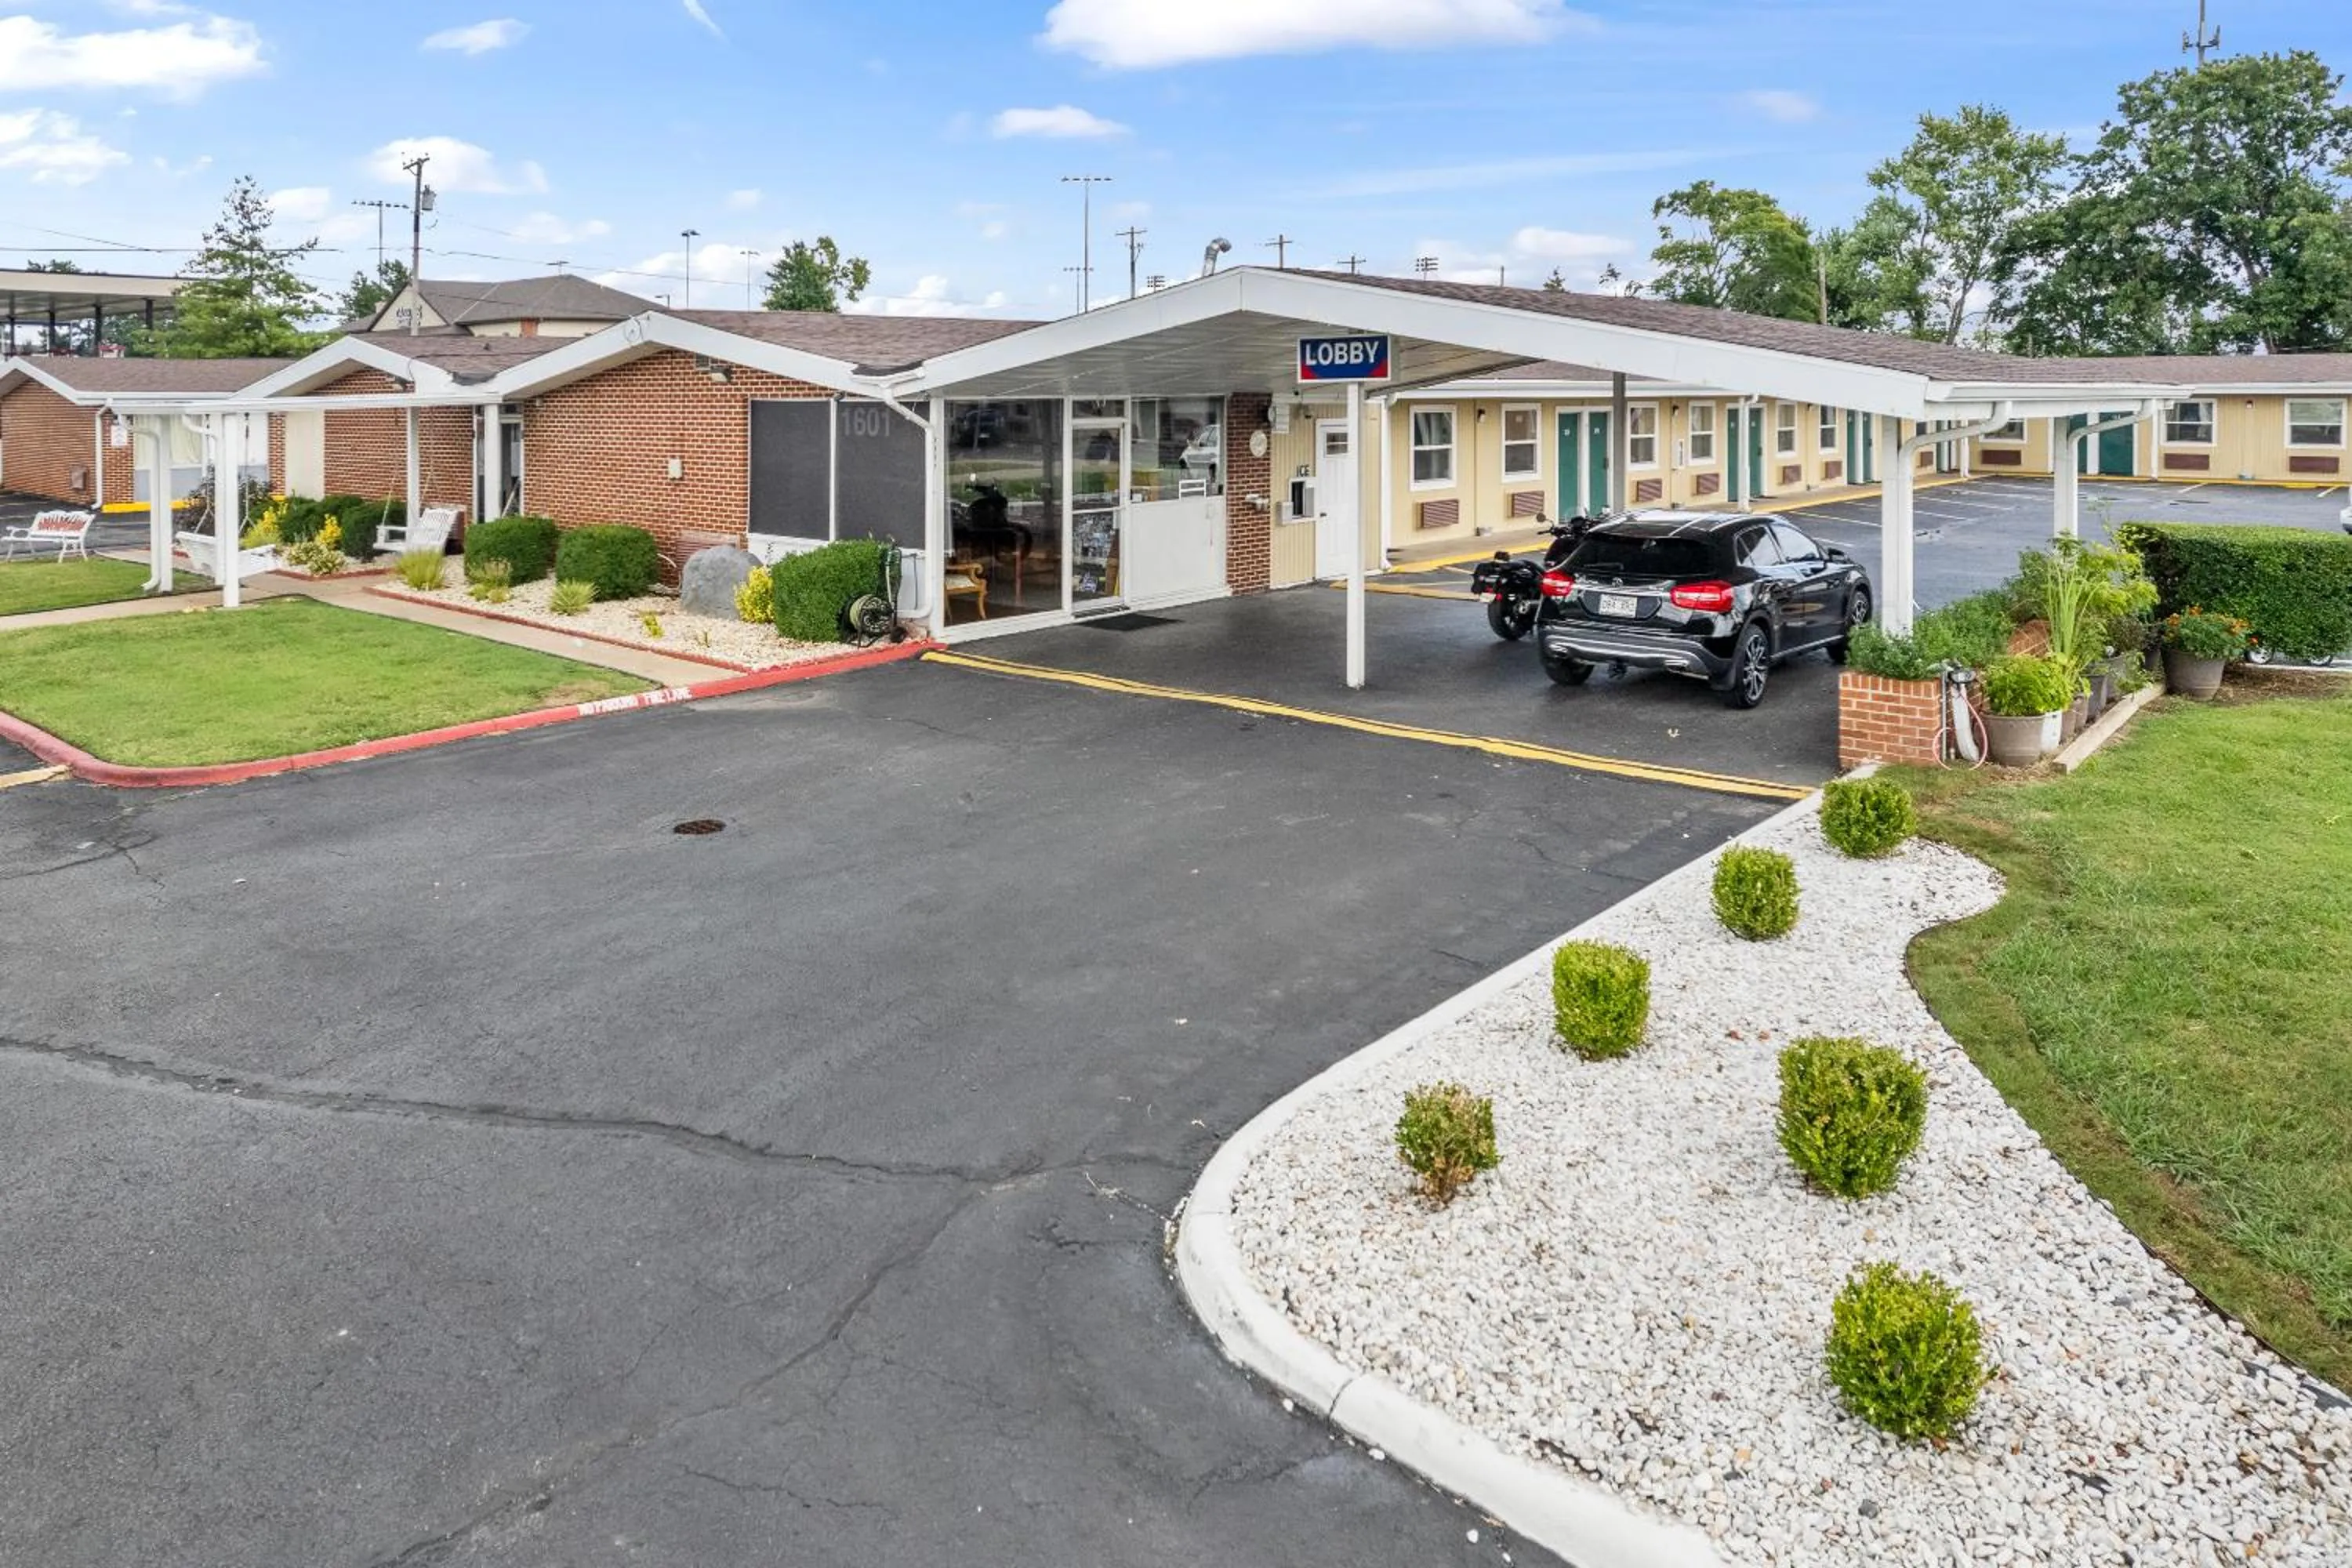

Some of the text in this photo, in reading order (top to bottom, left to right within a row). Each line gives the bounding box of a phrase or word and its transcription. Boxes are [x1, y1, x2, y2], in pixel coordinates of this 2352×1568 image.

[1305, 341, 1379, 365] LOBBY
[842, 407, 890, 437] 1601
[1296, 463, 1310, 477] ICE
